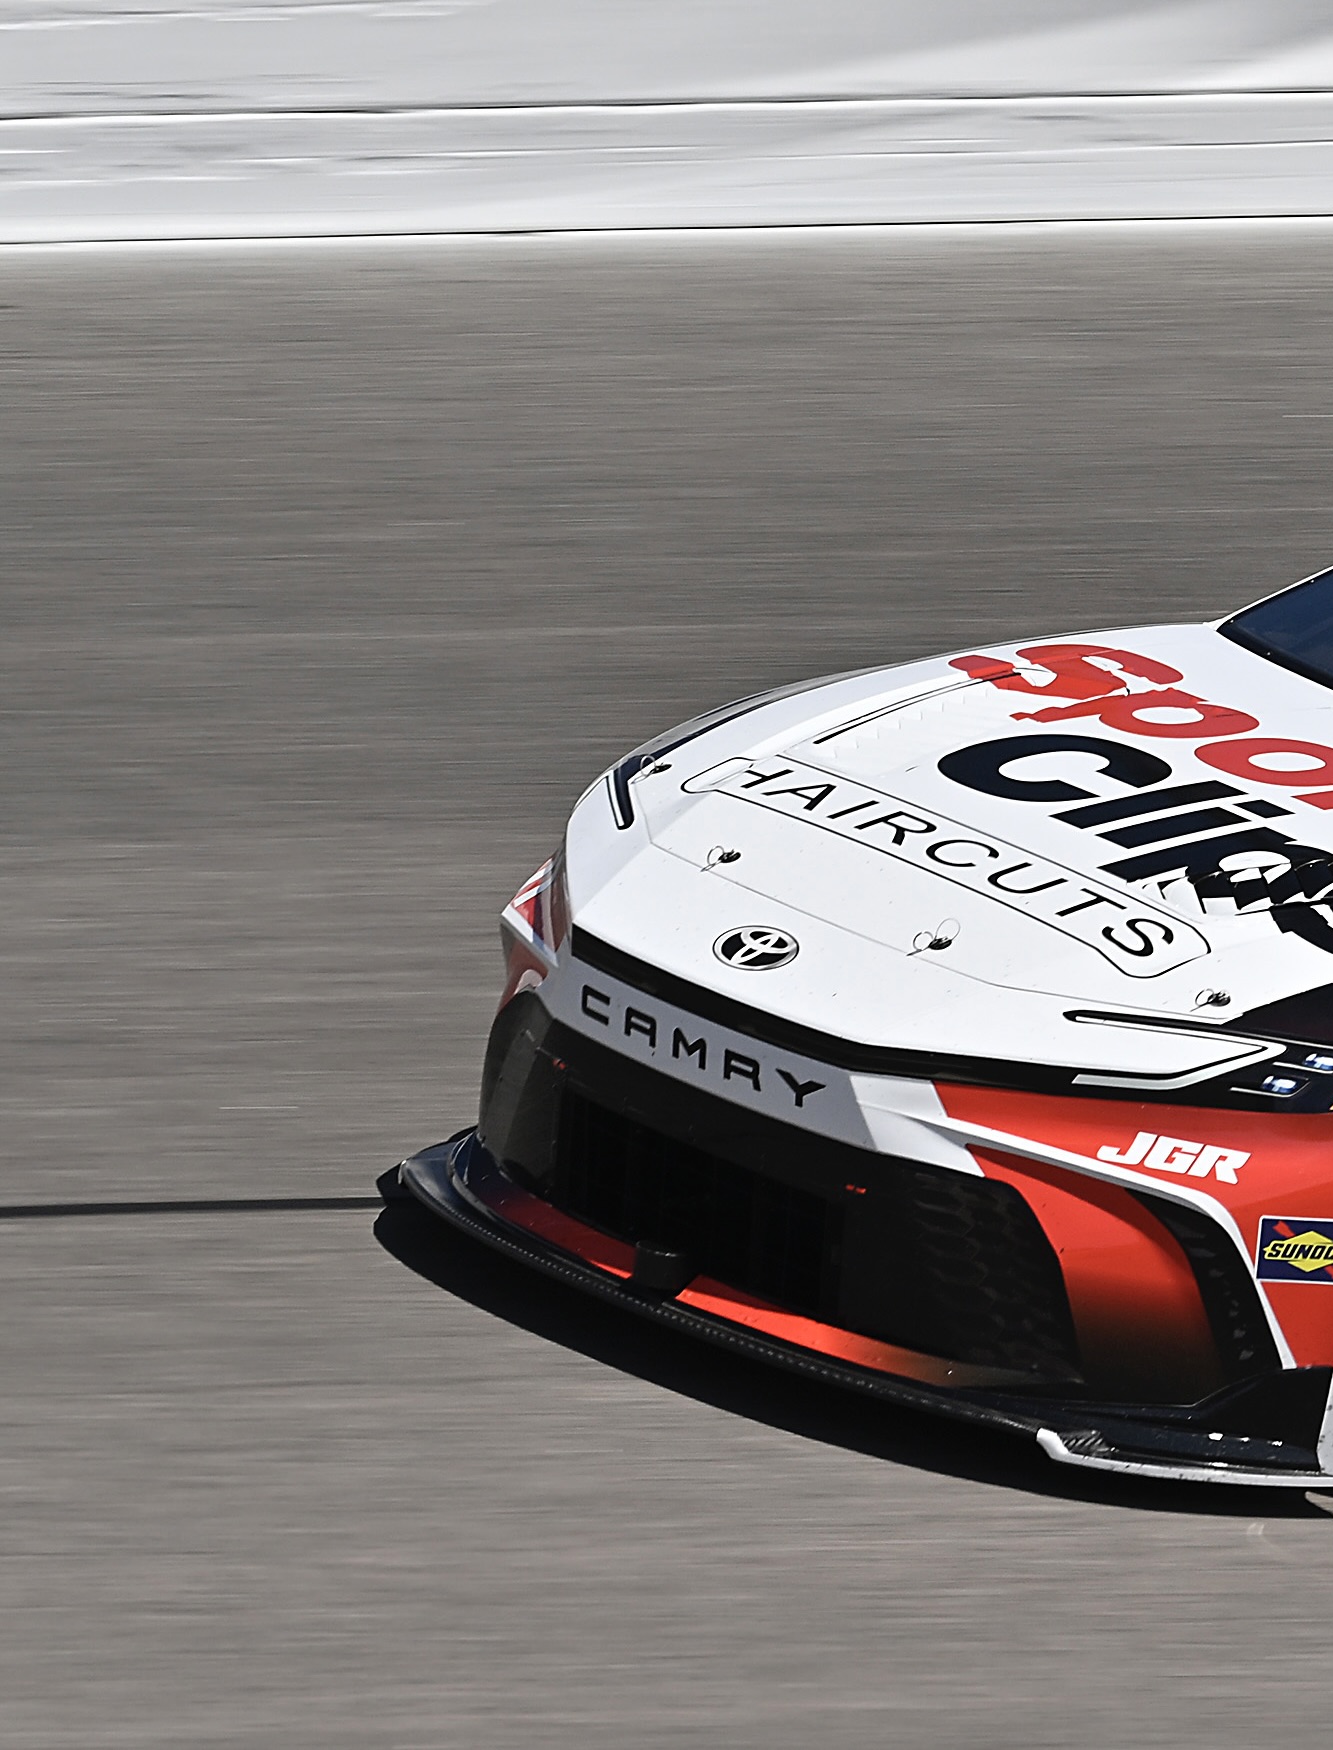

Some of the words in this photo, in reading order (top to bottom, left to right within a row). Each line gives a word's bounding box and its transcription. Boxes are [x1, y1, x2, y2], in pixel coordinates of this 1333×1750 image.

[726, 760, 1175, 960] HAIRCUTS
[581, 985, 828, 1108] CAMRY
[1096, 1131, 1252, 1185] JGR
